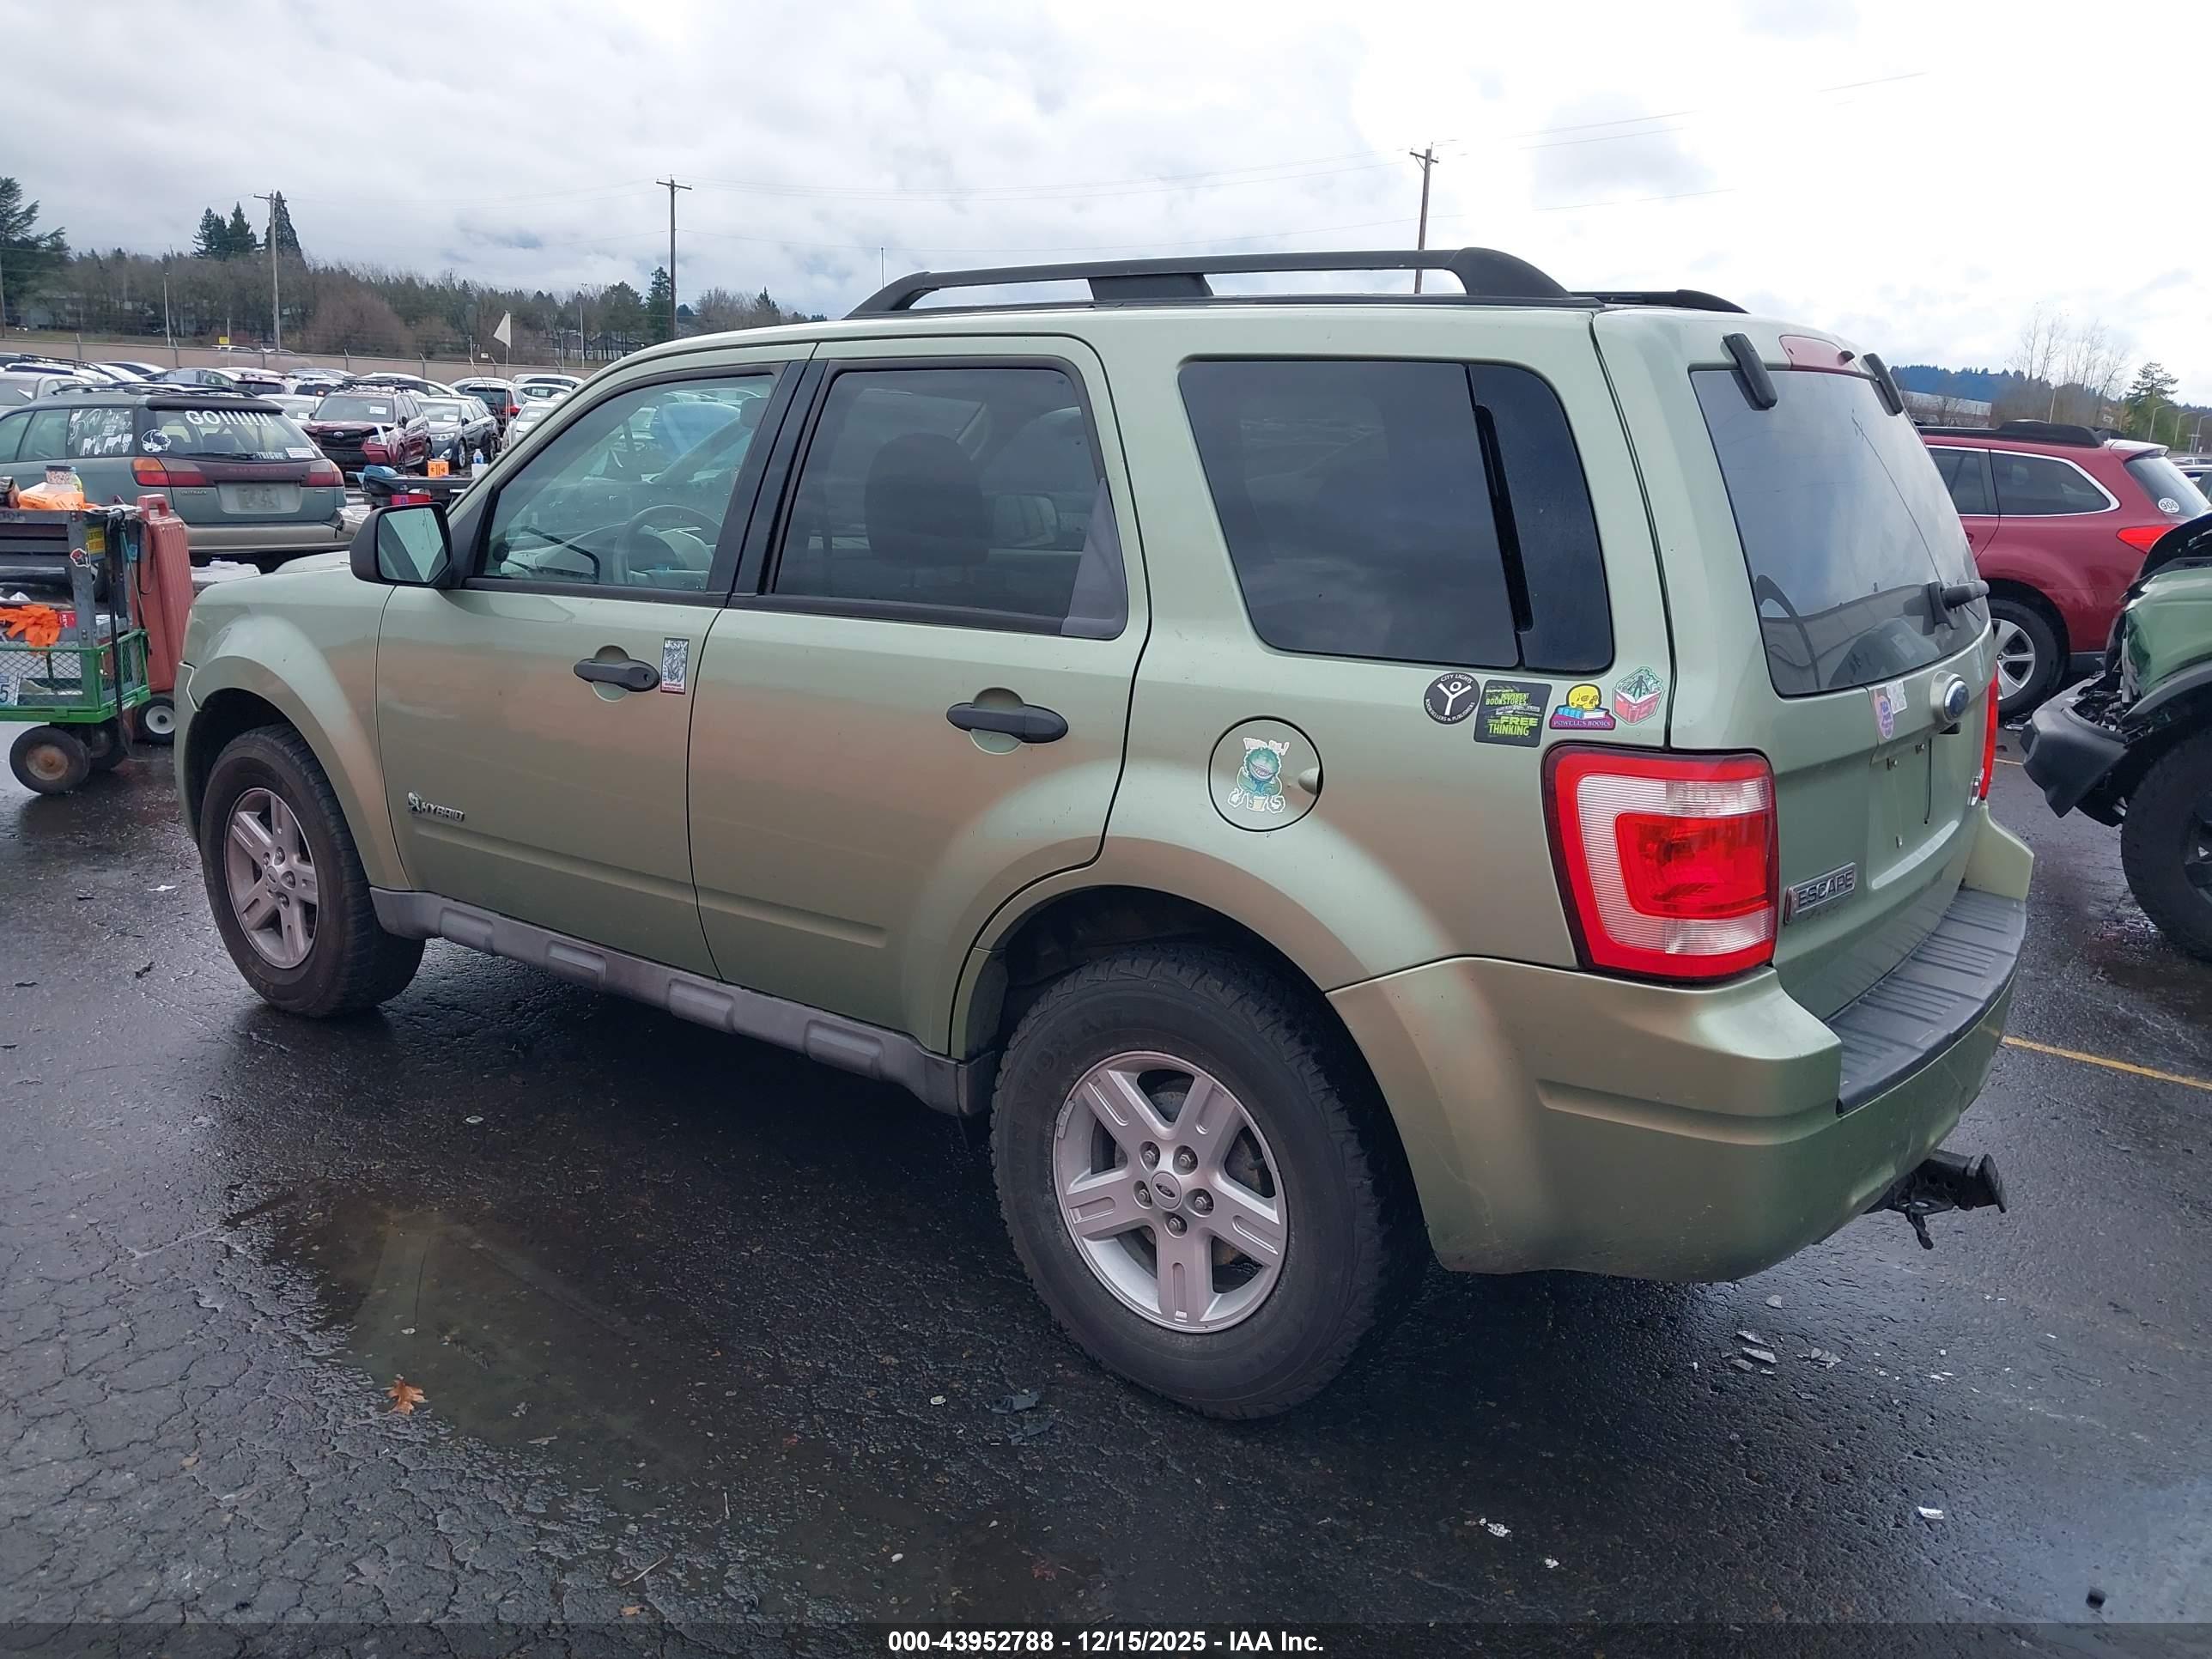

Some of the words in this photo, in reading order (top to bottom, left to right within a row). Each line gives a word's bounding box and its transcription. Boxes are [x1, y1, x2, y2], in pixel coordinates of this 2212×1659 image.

[1455, 673, 1474, 684] LIGHTS
[1425, 698, 1447, 721] BOOKSELLERS
[1451, 702, 1475, 720] PUBLISHERS
[1500, 716, 1538, 726] FREE
[1489, 724, 1530, 736] THINKING
[422, 801, 465, 822] HYBRID
[1797, 869, 1854, 908] ESCAPE
